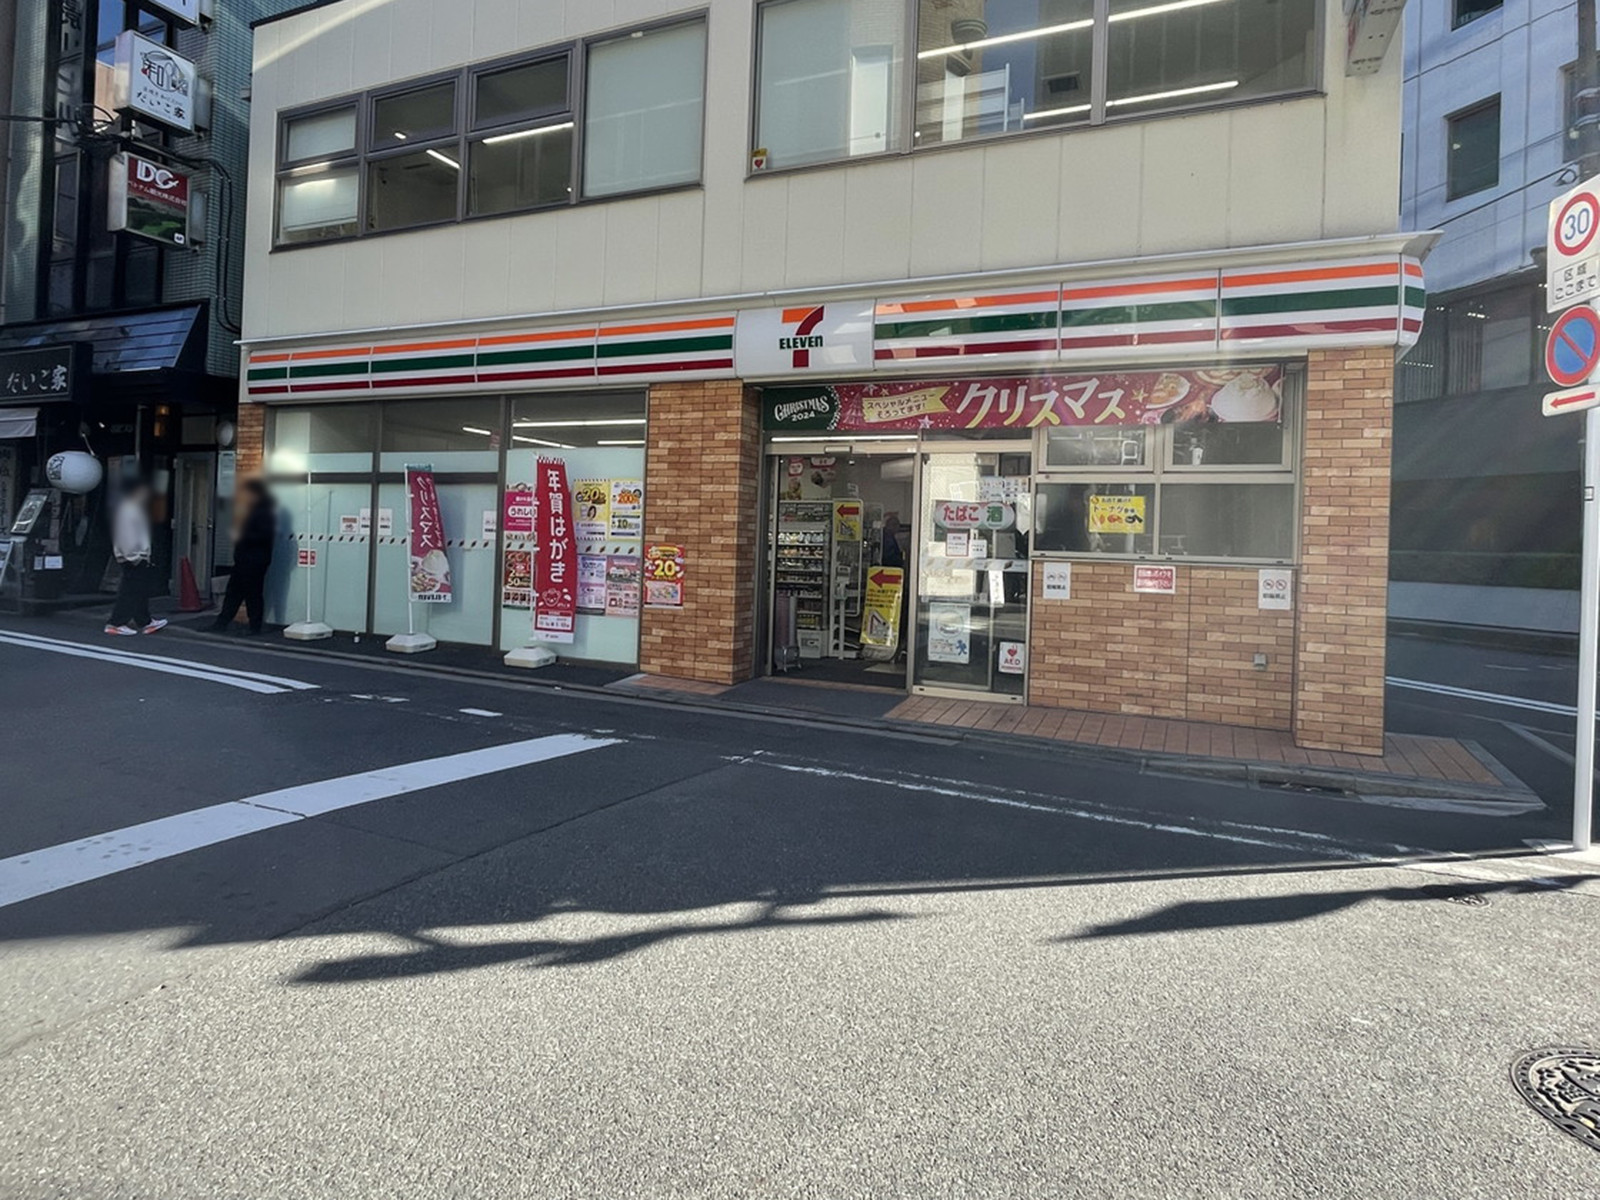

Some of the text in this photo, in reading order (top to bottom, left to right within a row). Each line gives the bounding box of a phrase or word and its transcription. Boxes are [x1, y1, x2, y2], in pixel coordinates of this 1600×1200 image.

[137, 91, 185, 119] だいこ家
[1565, 208, 1589, 240] 30
[1555, 275, 1596, 300] ここまで
[6, 365, 67, 393] だいこ家
[774, 395, 830, 421] CHRISTMAS
[867, 393, 936, 409] スペシャルメニュー
[956, 378, 1126, 428] クリスマス
[791, 411, 816, 421] 2024
[943, 505, 979, 521] たばこ
[987, 506, 1003, 522] 酒
[547, 469, 568, 583] 年賀はがき
[654, 560, 675, 576] 20
